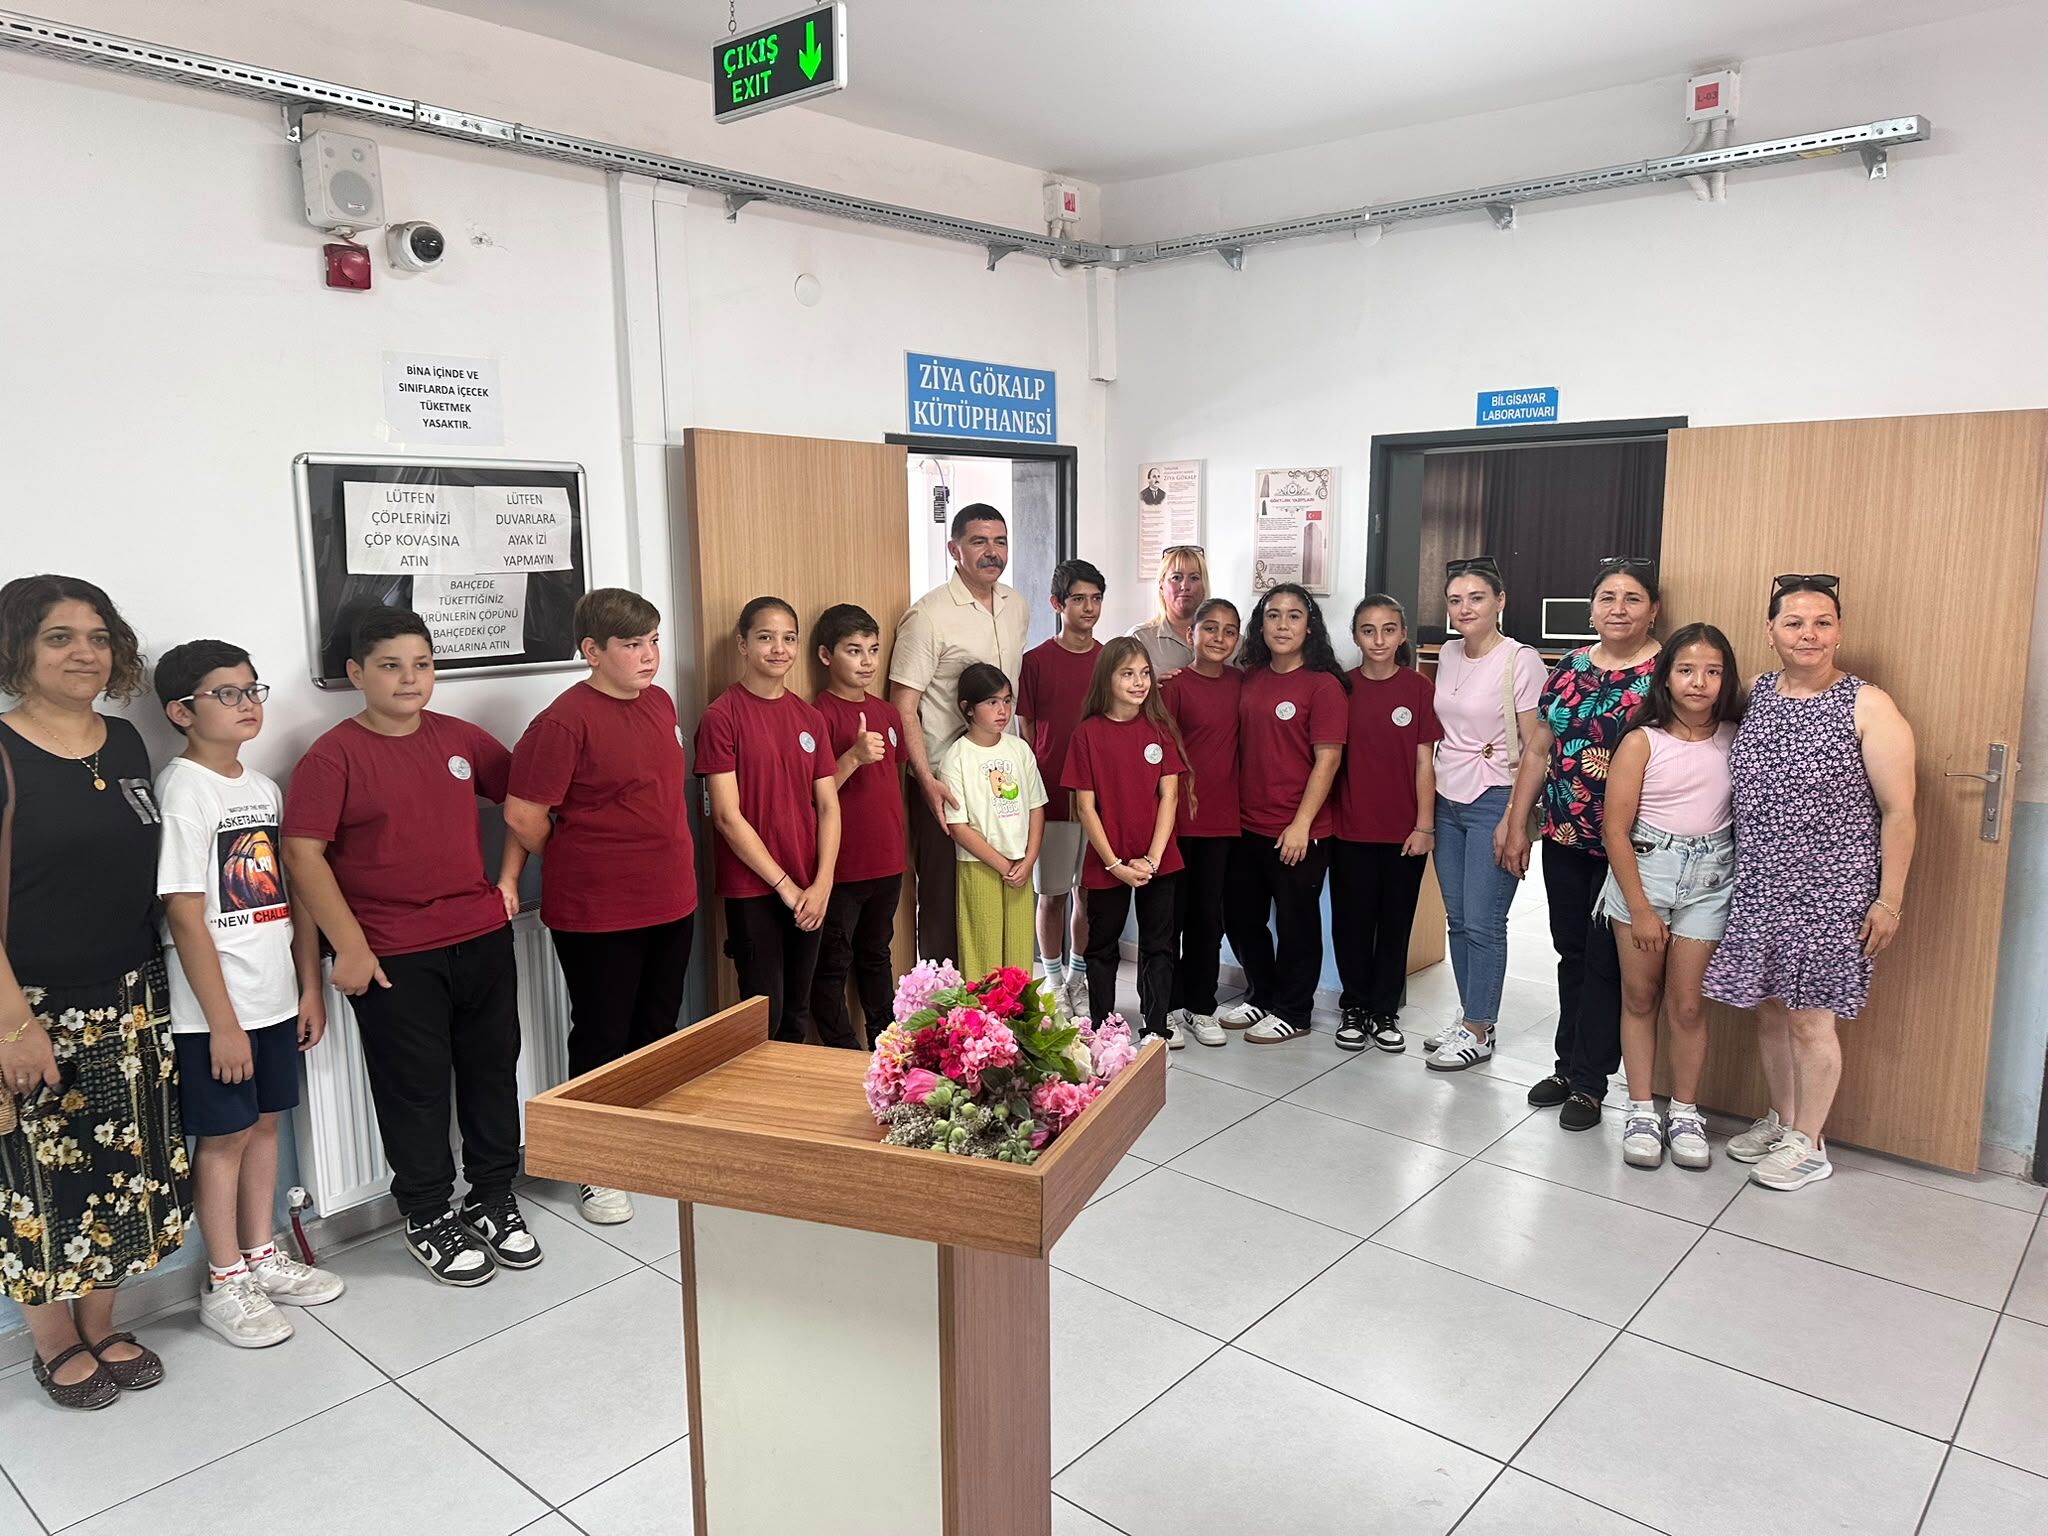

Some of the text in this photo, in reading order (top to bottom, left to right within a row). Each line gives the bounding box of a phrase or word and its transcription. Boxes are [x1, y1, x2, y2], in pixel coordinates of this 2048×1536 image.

[723, 34, 779, 78] ÇIKIŞ
[732, 70, 772, 103] EXIT
[406, 365, 479, 380] BİNA İÇİNDE VE
[919, 360, 1045, 400] ZİYA GÖKALP
[398, 383, 489, 397] SINIFLARDA İÇECEK
[420, 400, 472, 412] TÜKETMEK
[1492, 393, 1546, 406] BİLGİSAYAR
[913, 397, 1052, 435] KÜTÜPHANESİ
[1482, 406, 1555, 421] LABORATUVARI
[422, 419, 472, 429] YASAKTIR.
[386, 489, 435, 504] LÜTFEN
[506, 492, 543, 504] LÜTFEN
[371, 509, 451, 526] ÇÖPLERİNİZİ
[496, 513, 556, 525] DUVARLARA
[364, 531, 460, 549] ÇÖP KOVASINA
[508, 532, 547, 546] AYAK İZİ
[400, 555, 429, 567] ATIN
[503, 554, 554, 566] YAPMAYIN
[450, 580, 495, 591] BAHÇEDE
[433, 626, 486, 639] BAHÇEDEKİ
[432, 640, 510, 654] OVALARINA ATIN
